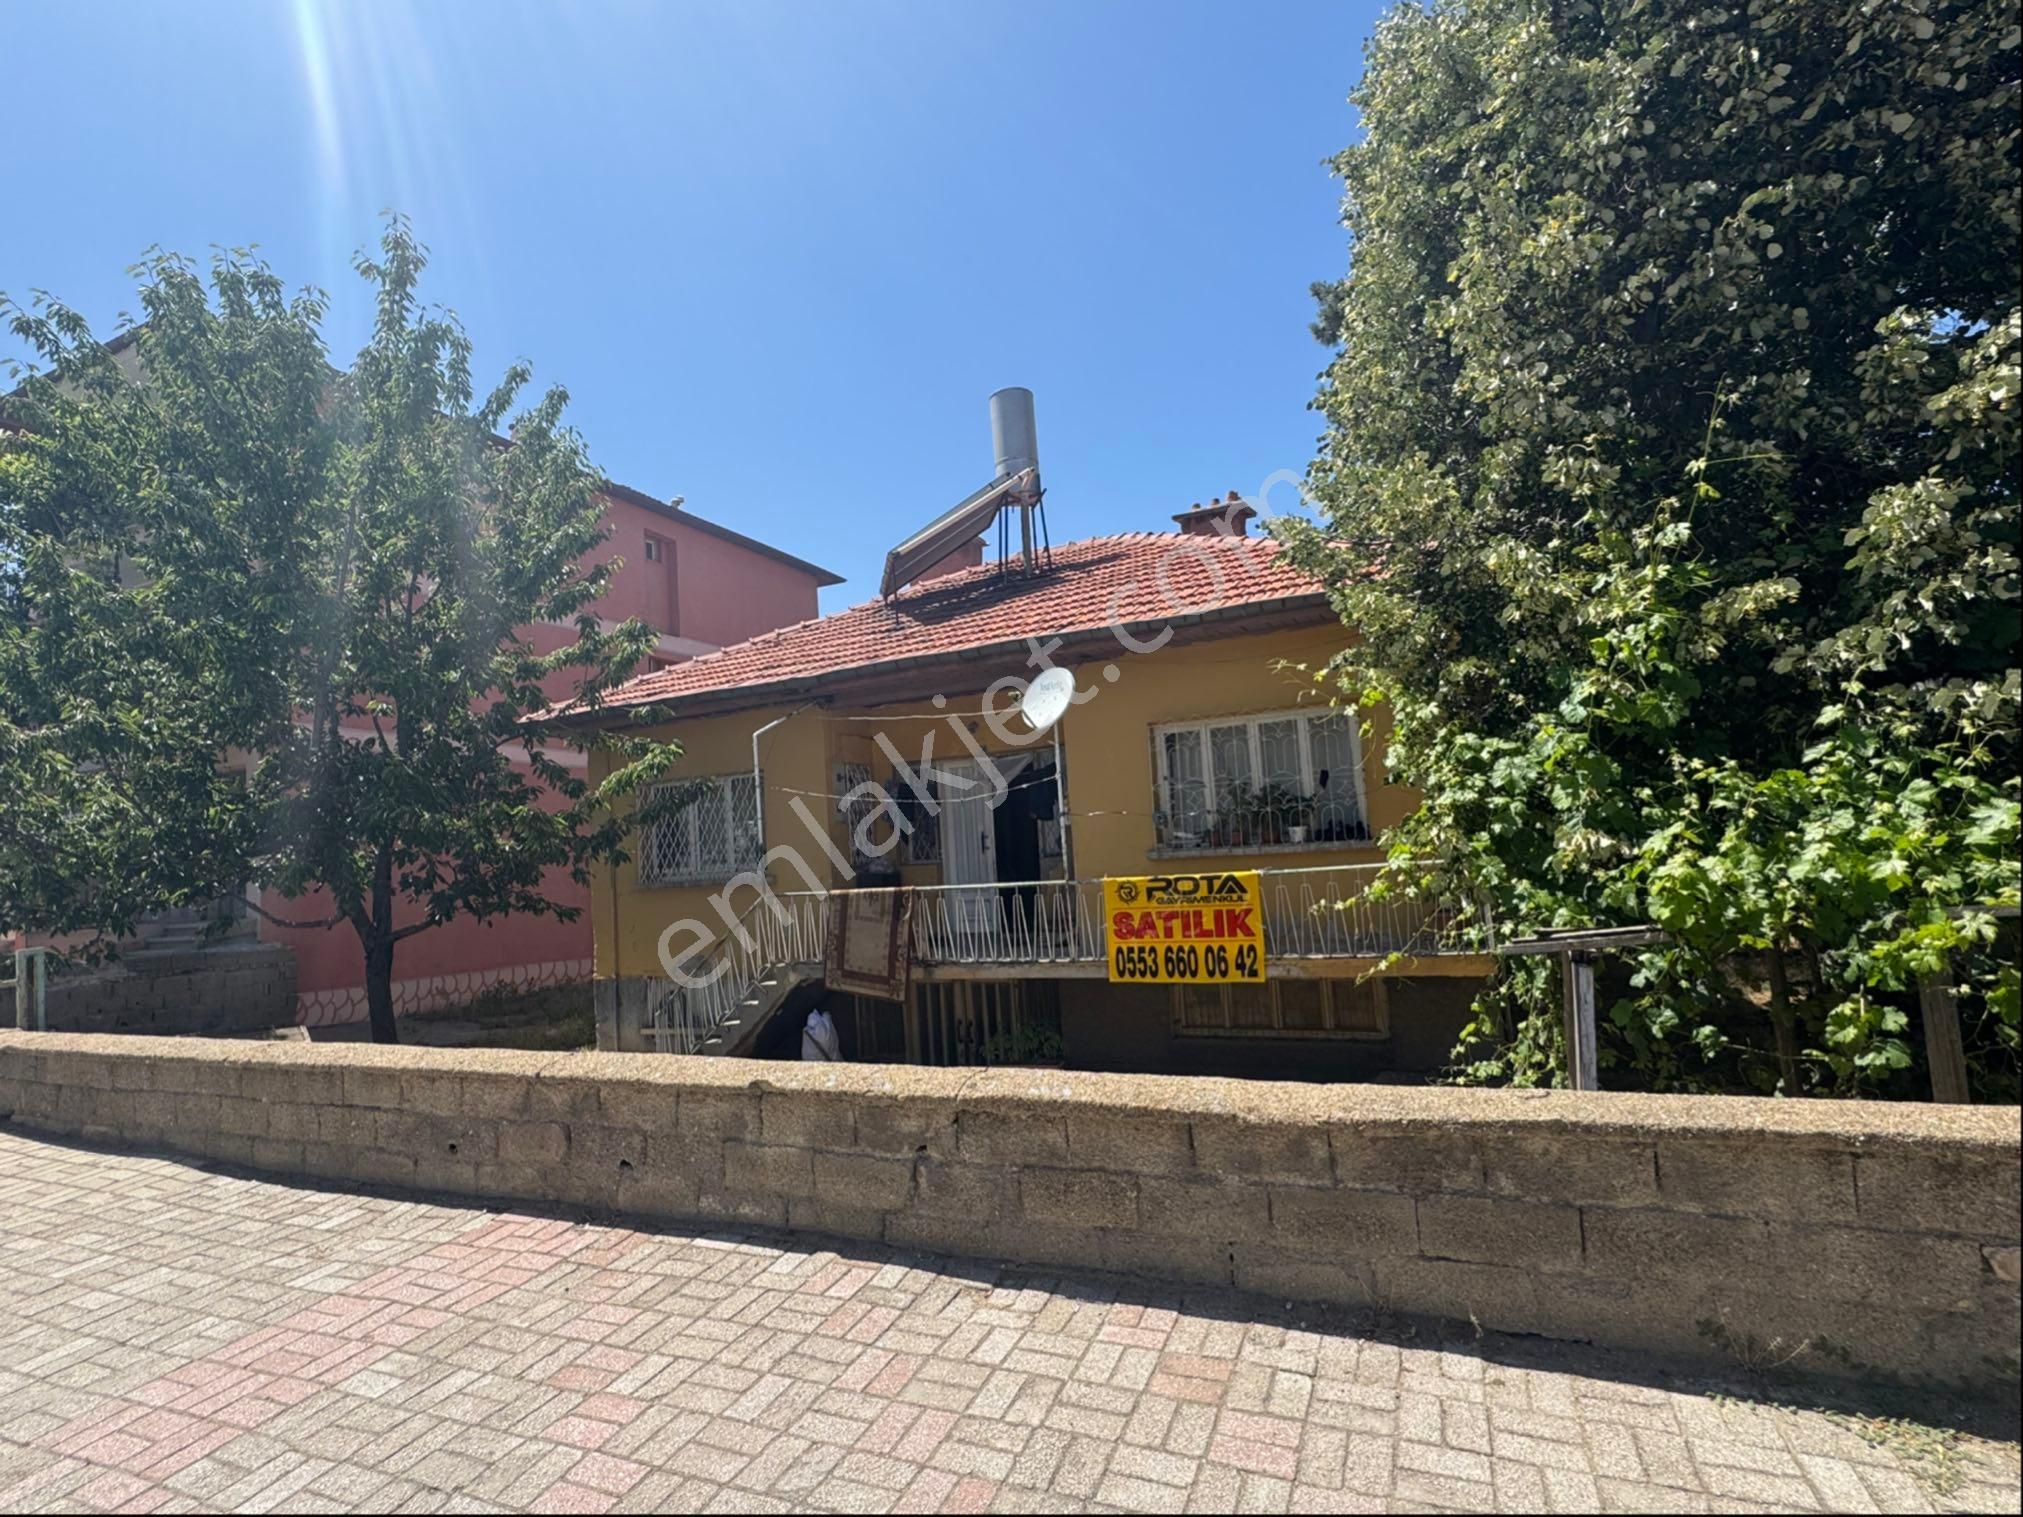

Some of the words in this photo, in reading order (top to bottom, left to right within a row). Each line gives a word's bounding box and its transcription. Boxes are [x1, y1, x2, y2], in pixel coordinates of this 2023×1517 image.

[1146, 874, 1248, 902] ROTA
[1113, 908, 1255, 940] SATILIK
[1116, 945, 1159, 978] 0553
[1164, 945, 1198, 978] 660
[1204, 944, 1229, 978] 06
[1235, 943, 1258, 978] 42
